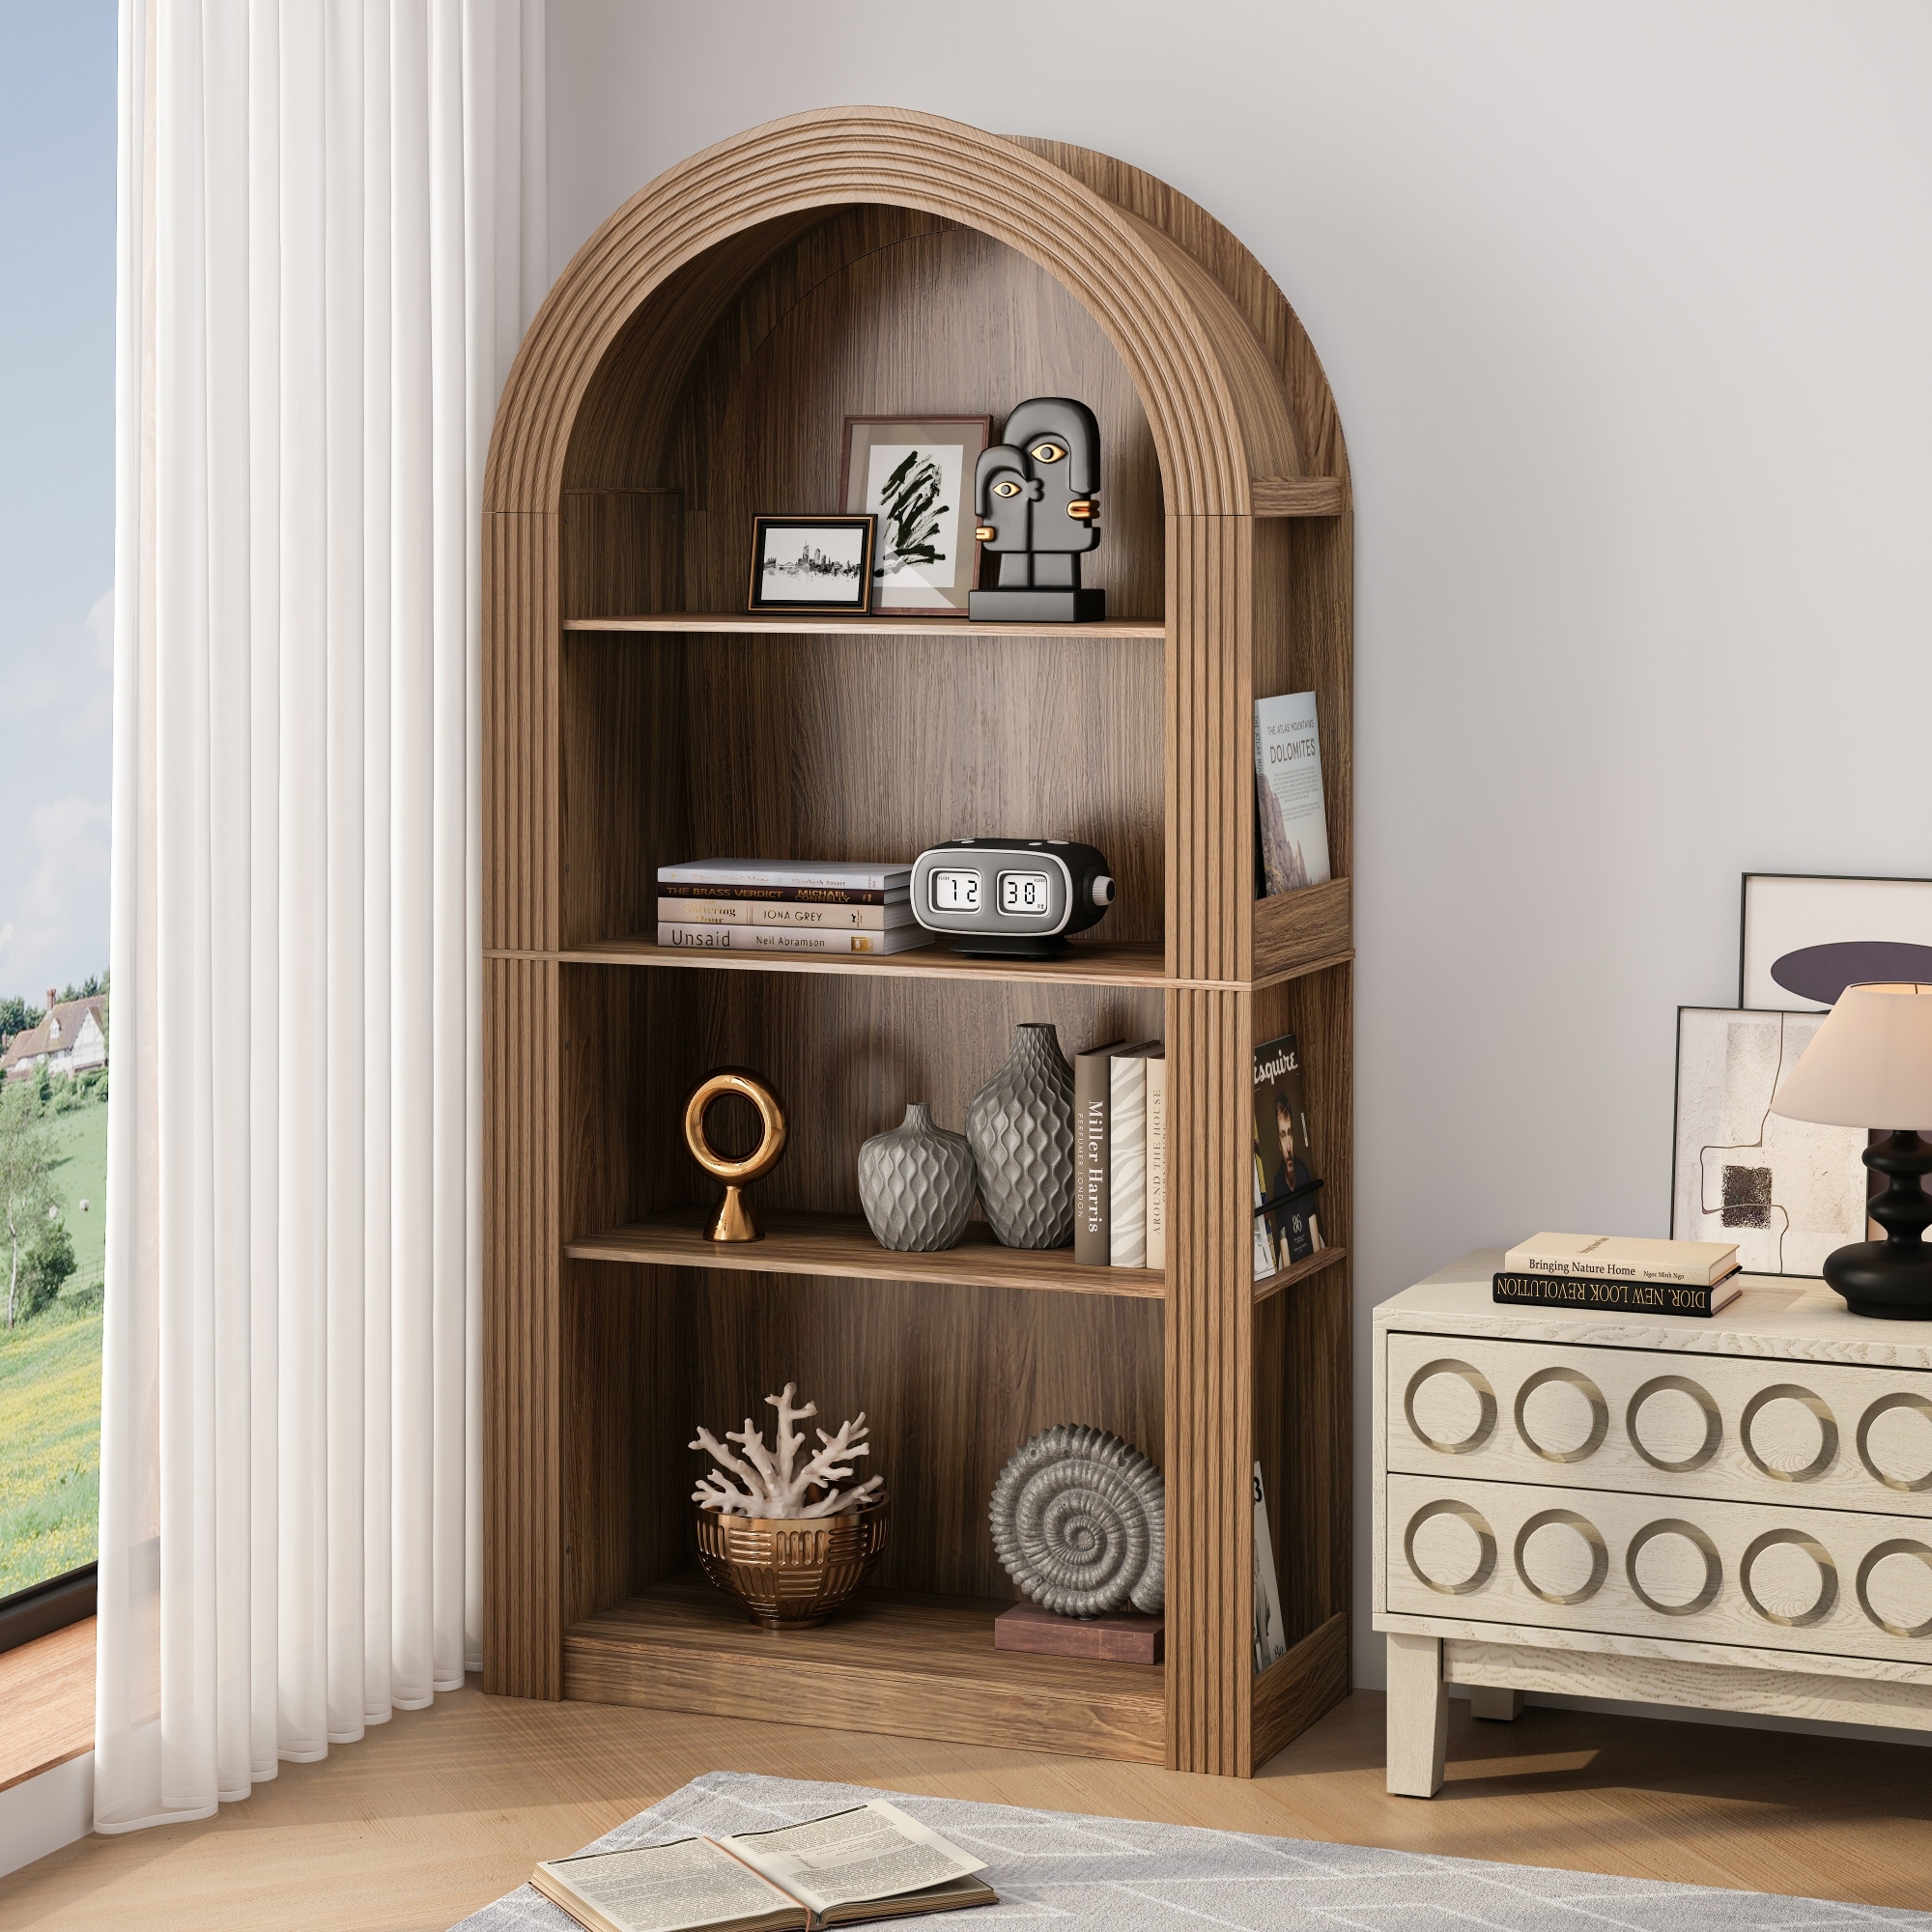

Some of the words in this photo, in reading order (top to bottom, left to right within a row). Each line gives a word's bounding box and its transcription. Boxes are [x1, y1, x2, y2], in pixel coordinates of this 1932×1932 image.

[1266, 725, 1276, 735] THE
[1277, 723, 1291, 734] ATLAS
[1291, 719, 1315, 732] MOUNTAINS
[1269, 737, 1316, 764] DOLOMITES
[667, 887, 690, 895] THE
[693, 888, 731, 896] BRASS
[734, 889, 783, 898] VERDICT
[794, 895, 850, 903] CONNELLY
[798, 889, 848, 897] MICHAEL
[952, 879, 978, 902] 12
[1008, 881, 1035, 905] 30
[763, 909, 791, 920] IONA
[794, 911, 823, 922] GREY
[671, 929, 731, 947] Unsaid
[755, 935, 775, 946] Neil
[778, 936, 825, 947] Abramson
[1152, 1089, 1161, 1136] HOUSE
[1088, 1100, 1103, 1163] Miller
[1152, 1142, 1161, 1170] THE
[1088, 1168, 1103, 1233] Harris
[1152, 1175, 1161, 1236] AROUND
[1529, 1259, 1570, 1274] Bringing
[1571, 1262, 1605, 1273] Nature
[1606, 1264, 1636, 1276] Home
[1643, 1270, 1658, 1279] Ngoc
[1673, 1272, 1685, 1281] Ngo
[1496, 1277, 1586, 1301] REVOLUTION
[1589, 1284, 1629, 1303] LOOK
[1632, 1287, 1664, 1306] NEW
[1667, 1289, 1706, 1309] DIOR.
